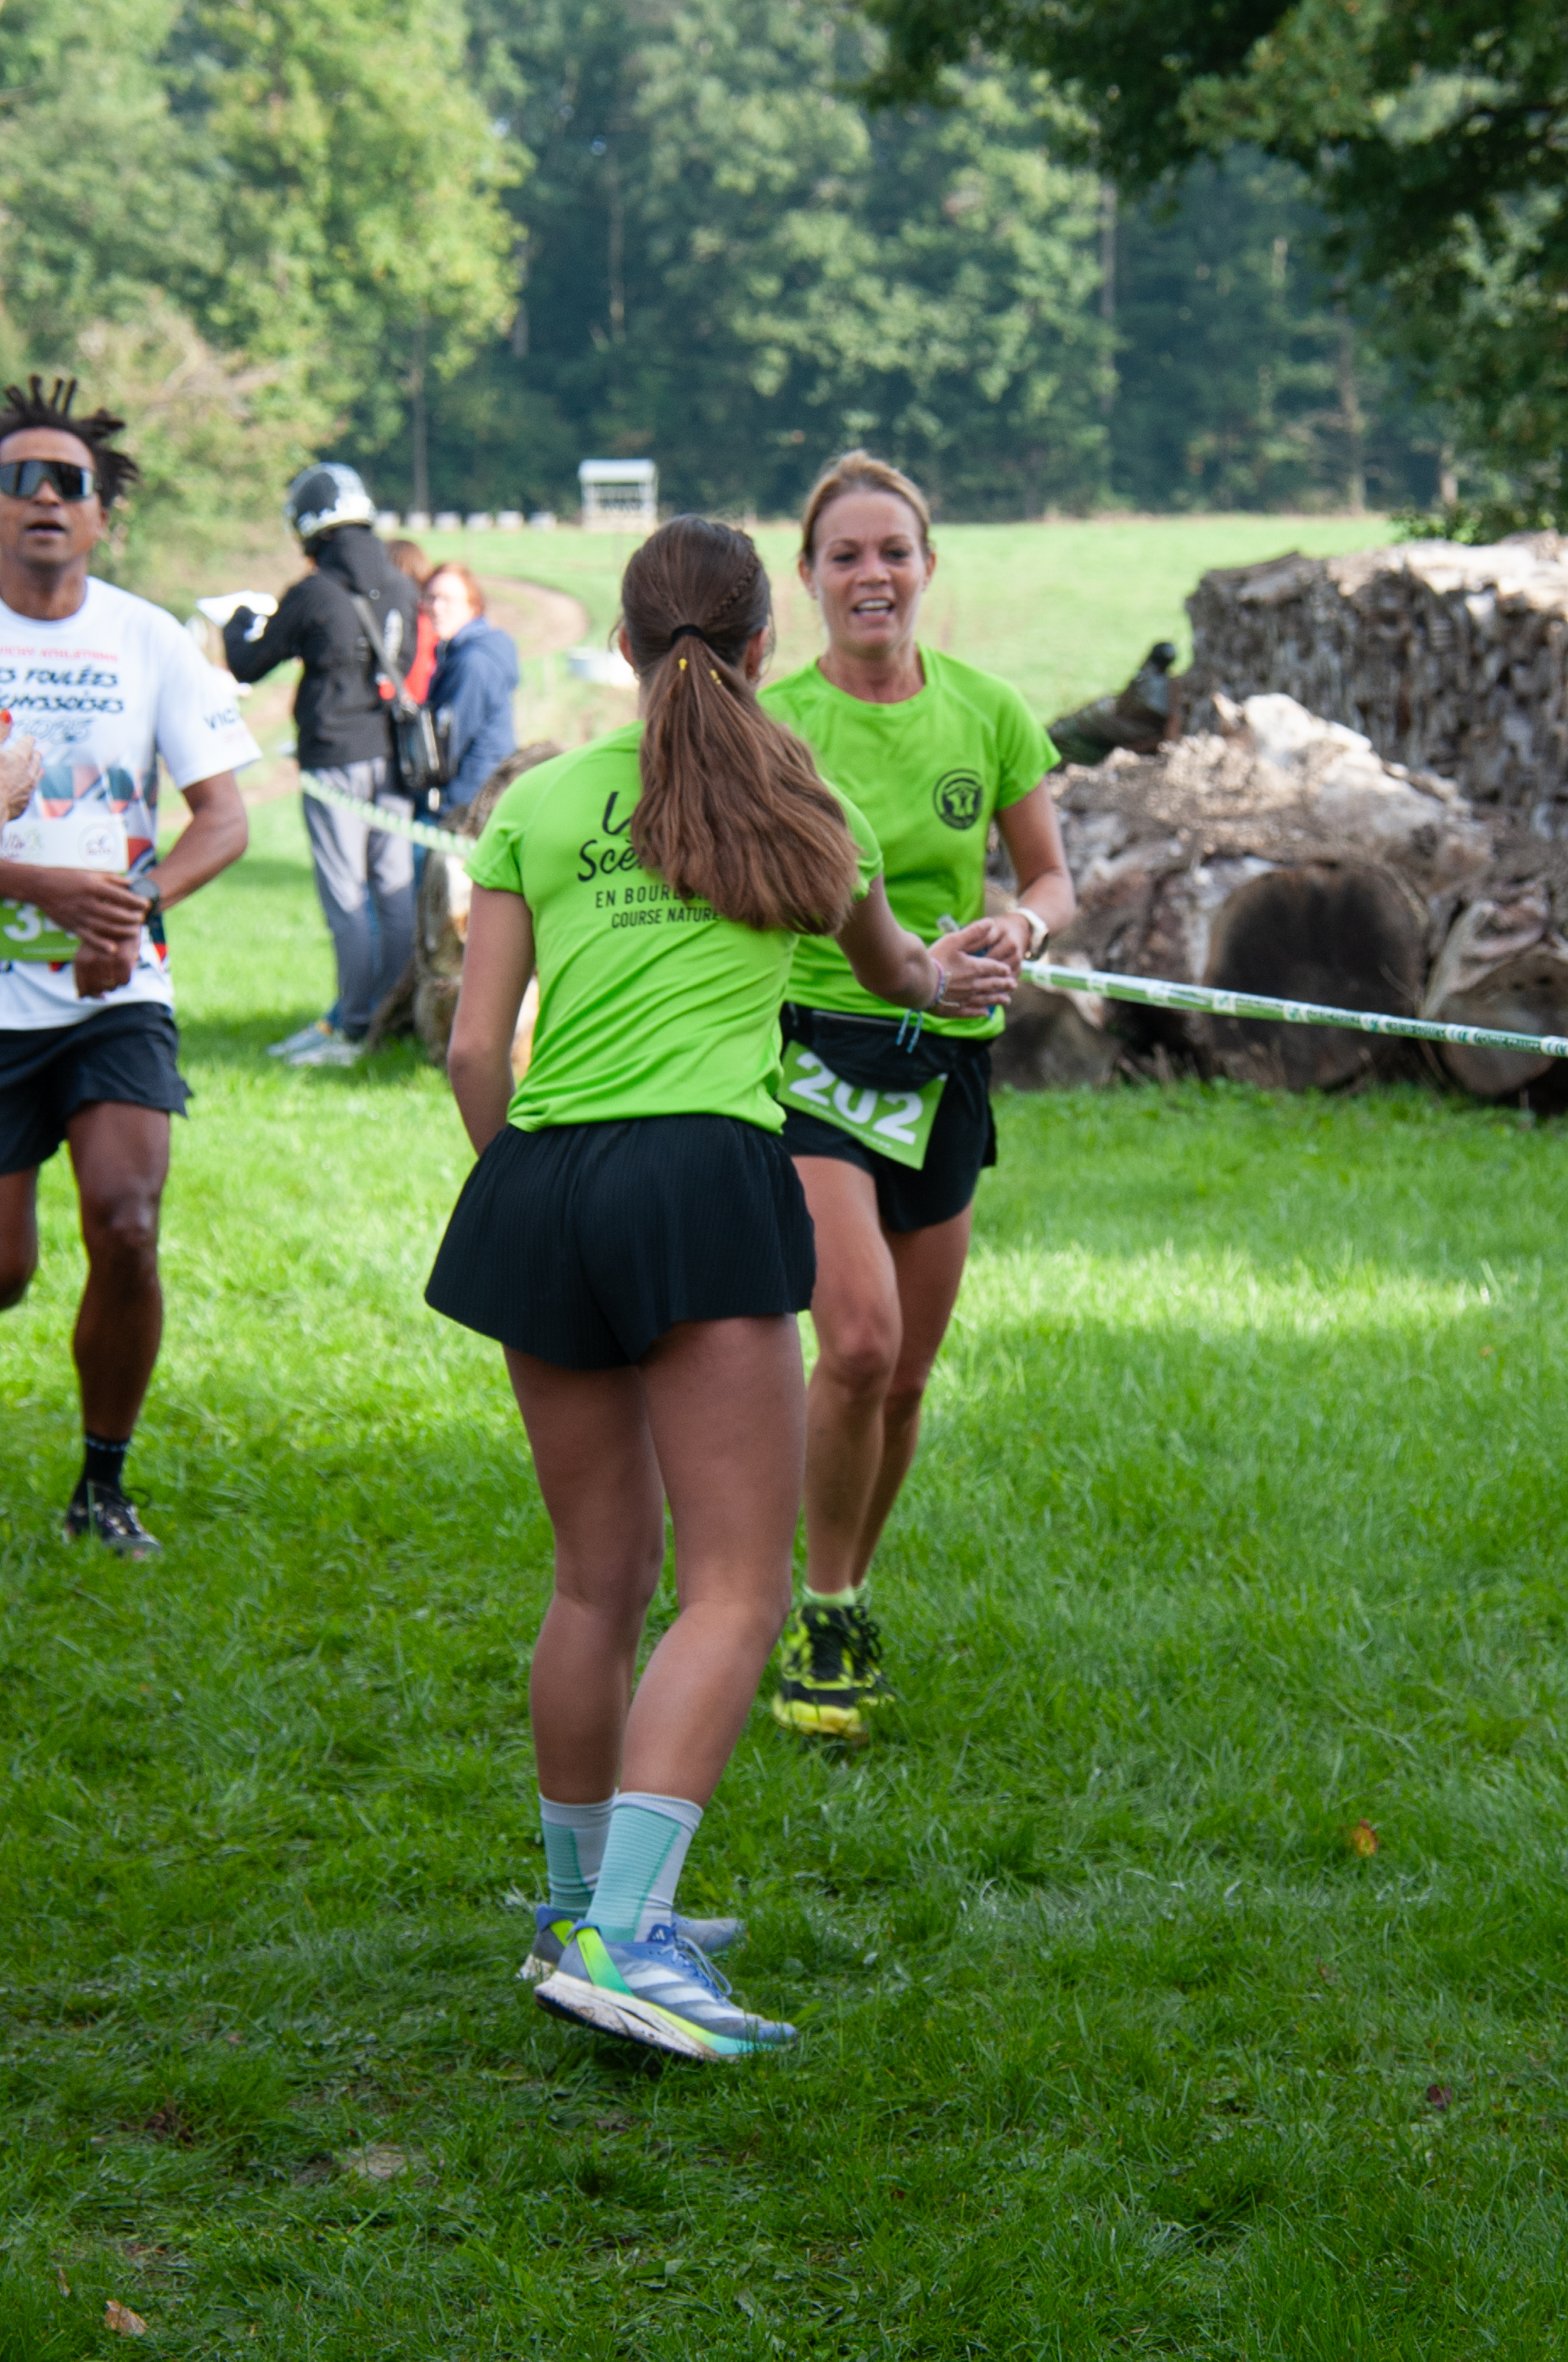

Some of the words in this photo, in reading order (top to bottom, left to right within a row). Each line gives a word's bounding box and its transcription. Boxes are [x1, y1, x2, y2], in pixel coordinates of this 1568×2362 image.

[0, 668, 17, 683] S
[203, 707, 240, 731] VIC
[602, 790, 633, 836] L
[577, 838, 643, 883] Scè
[595, 889, 617, 908] EN
[624, 883, 704, 905] BOUR
[611, 908, 664, 929] COURSE
[666, 905, 721, 924] NATURE
[788, 1051, 923, 1147] 202
